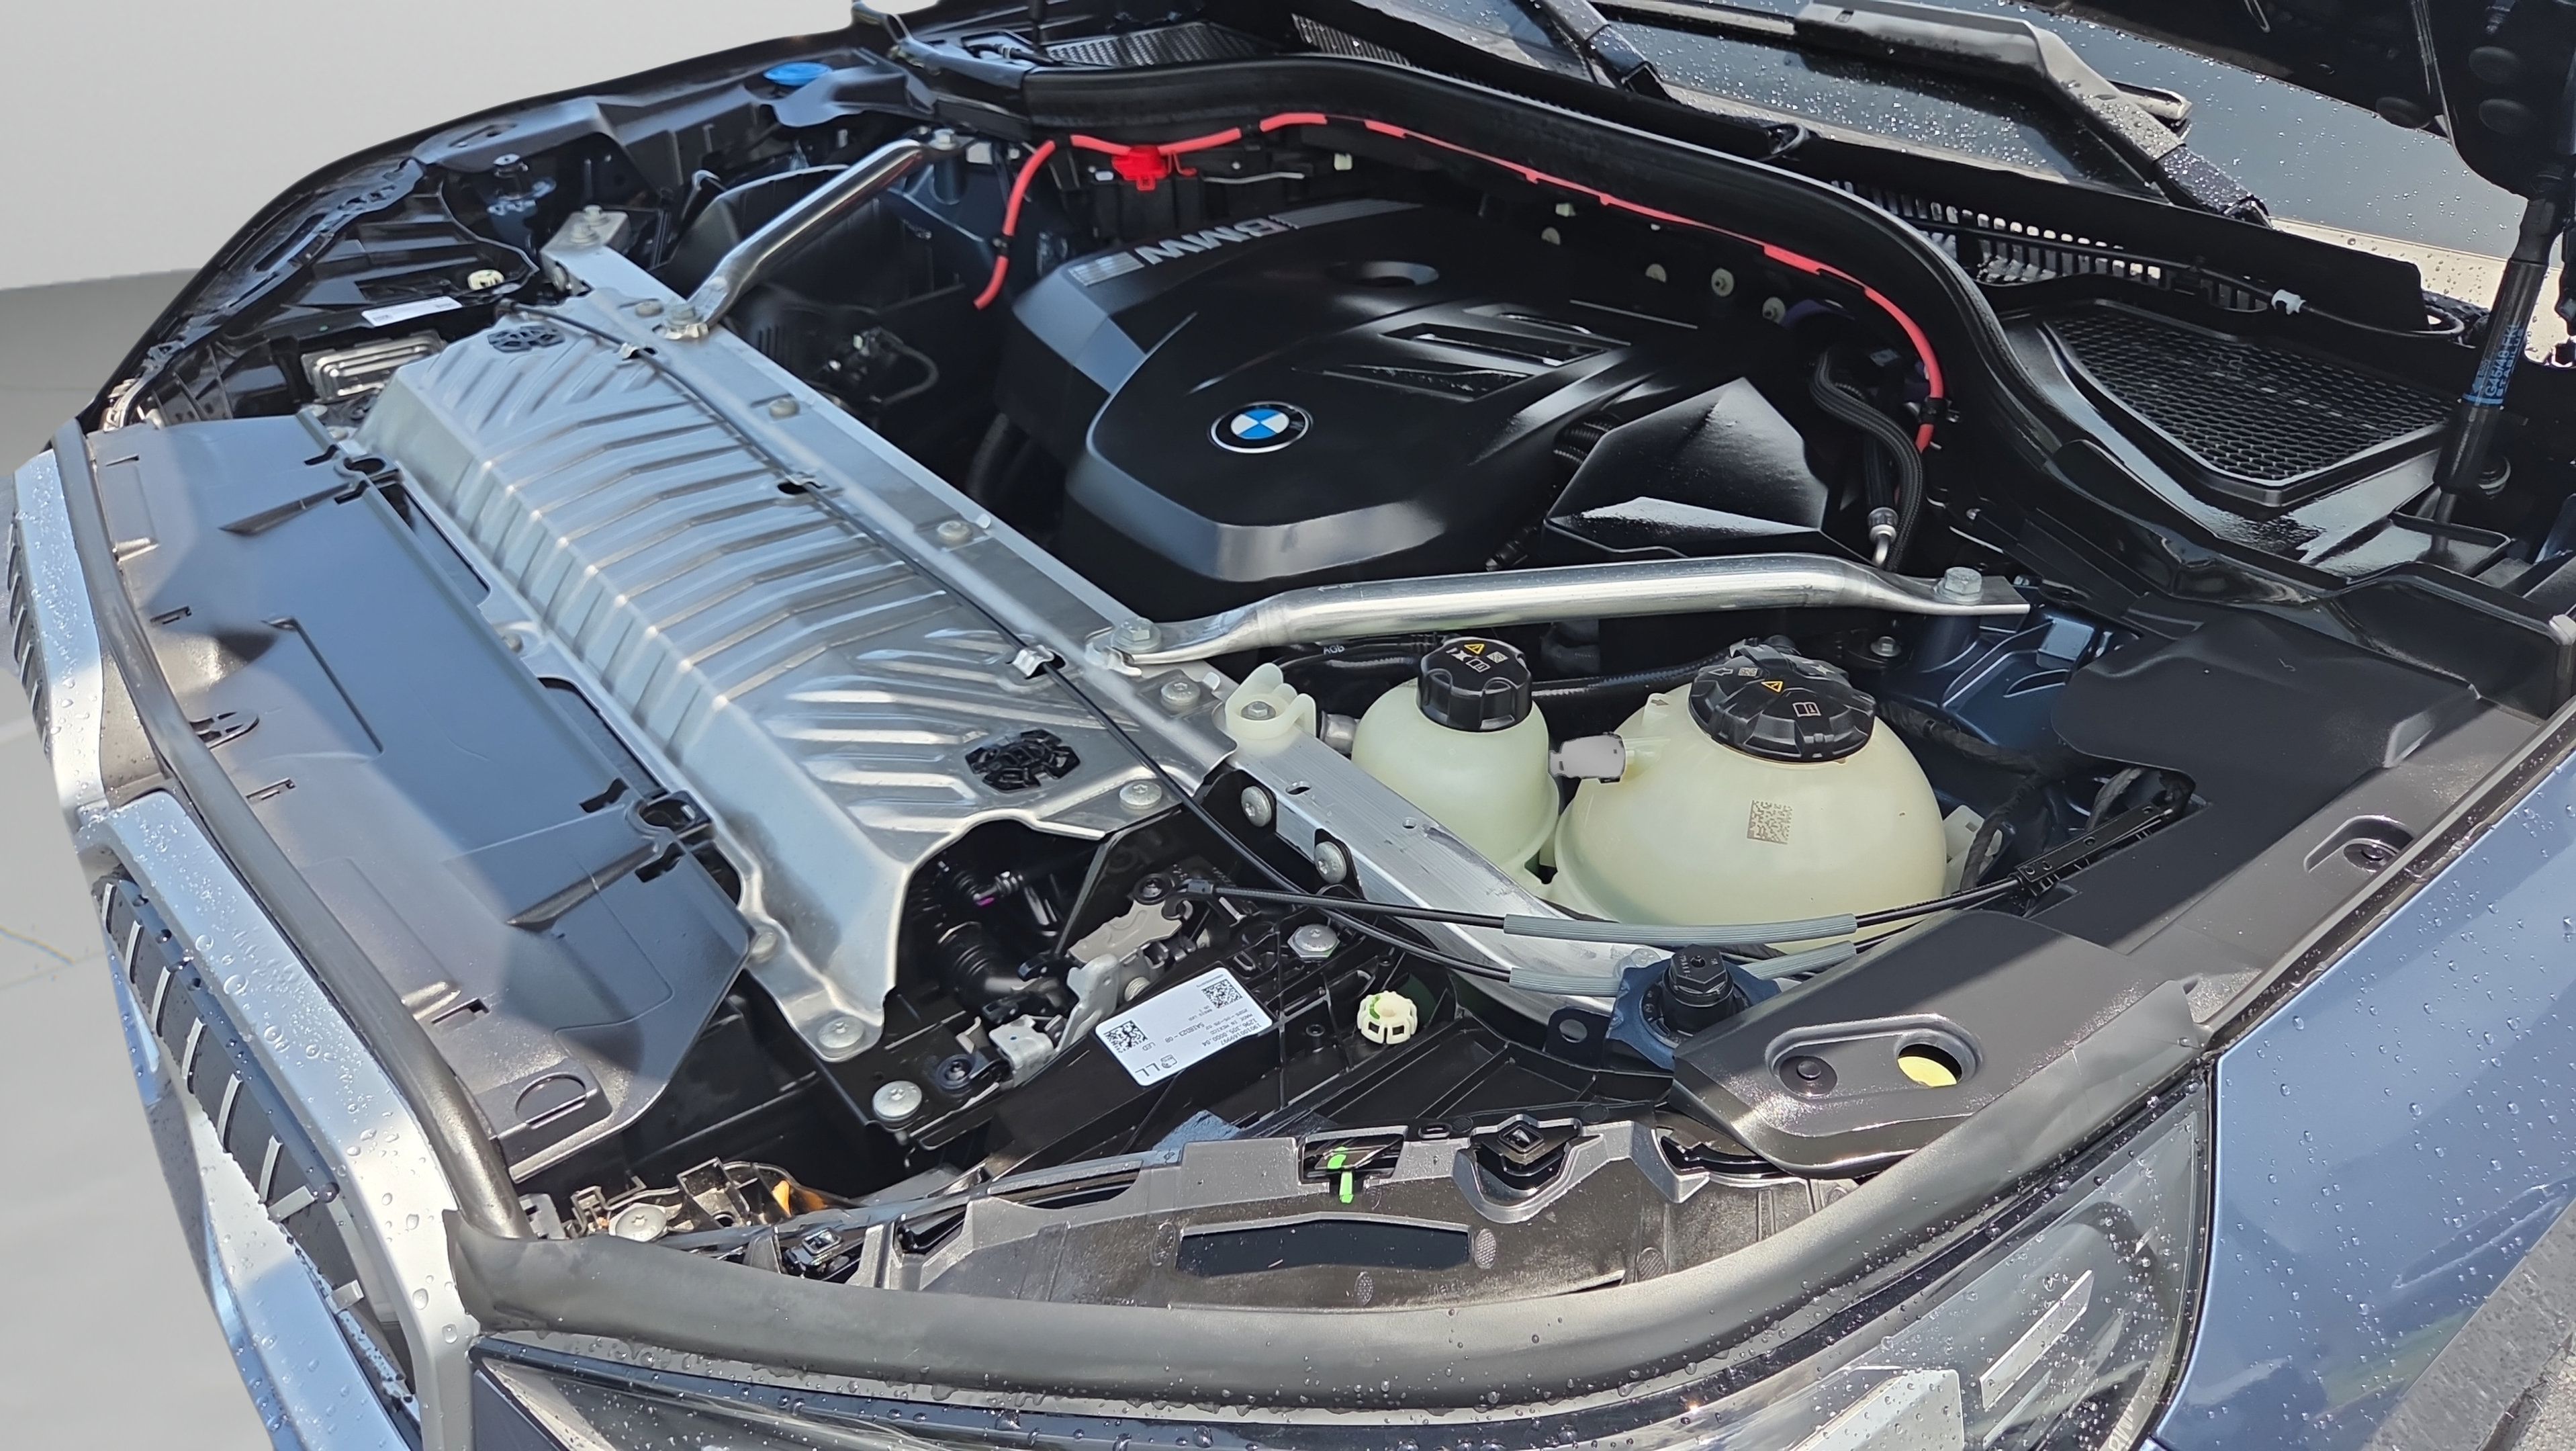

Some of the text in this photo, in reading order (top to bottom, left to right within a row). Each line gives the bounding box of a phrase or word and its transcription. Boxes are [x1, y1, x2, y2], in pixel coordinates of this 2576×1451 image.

[1135, 218, 1289, 265] BMW
[2495, 328, 2524, 397] STABILUS
[1209, 1023, 1230, 1035] MEXICO
[1142, 1041, 1156, 1051] LED
[1134, 1063, 1161, 1078] LL
